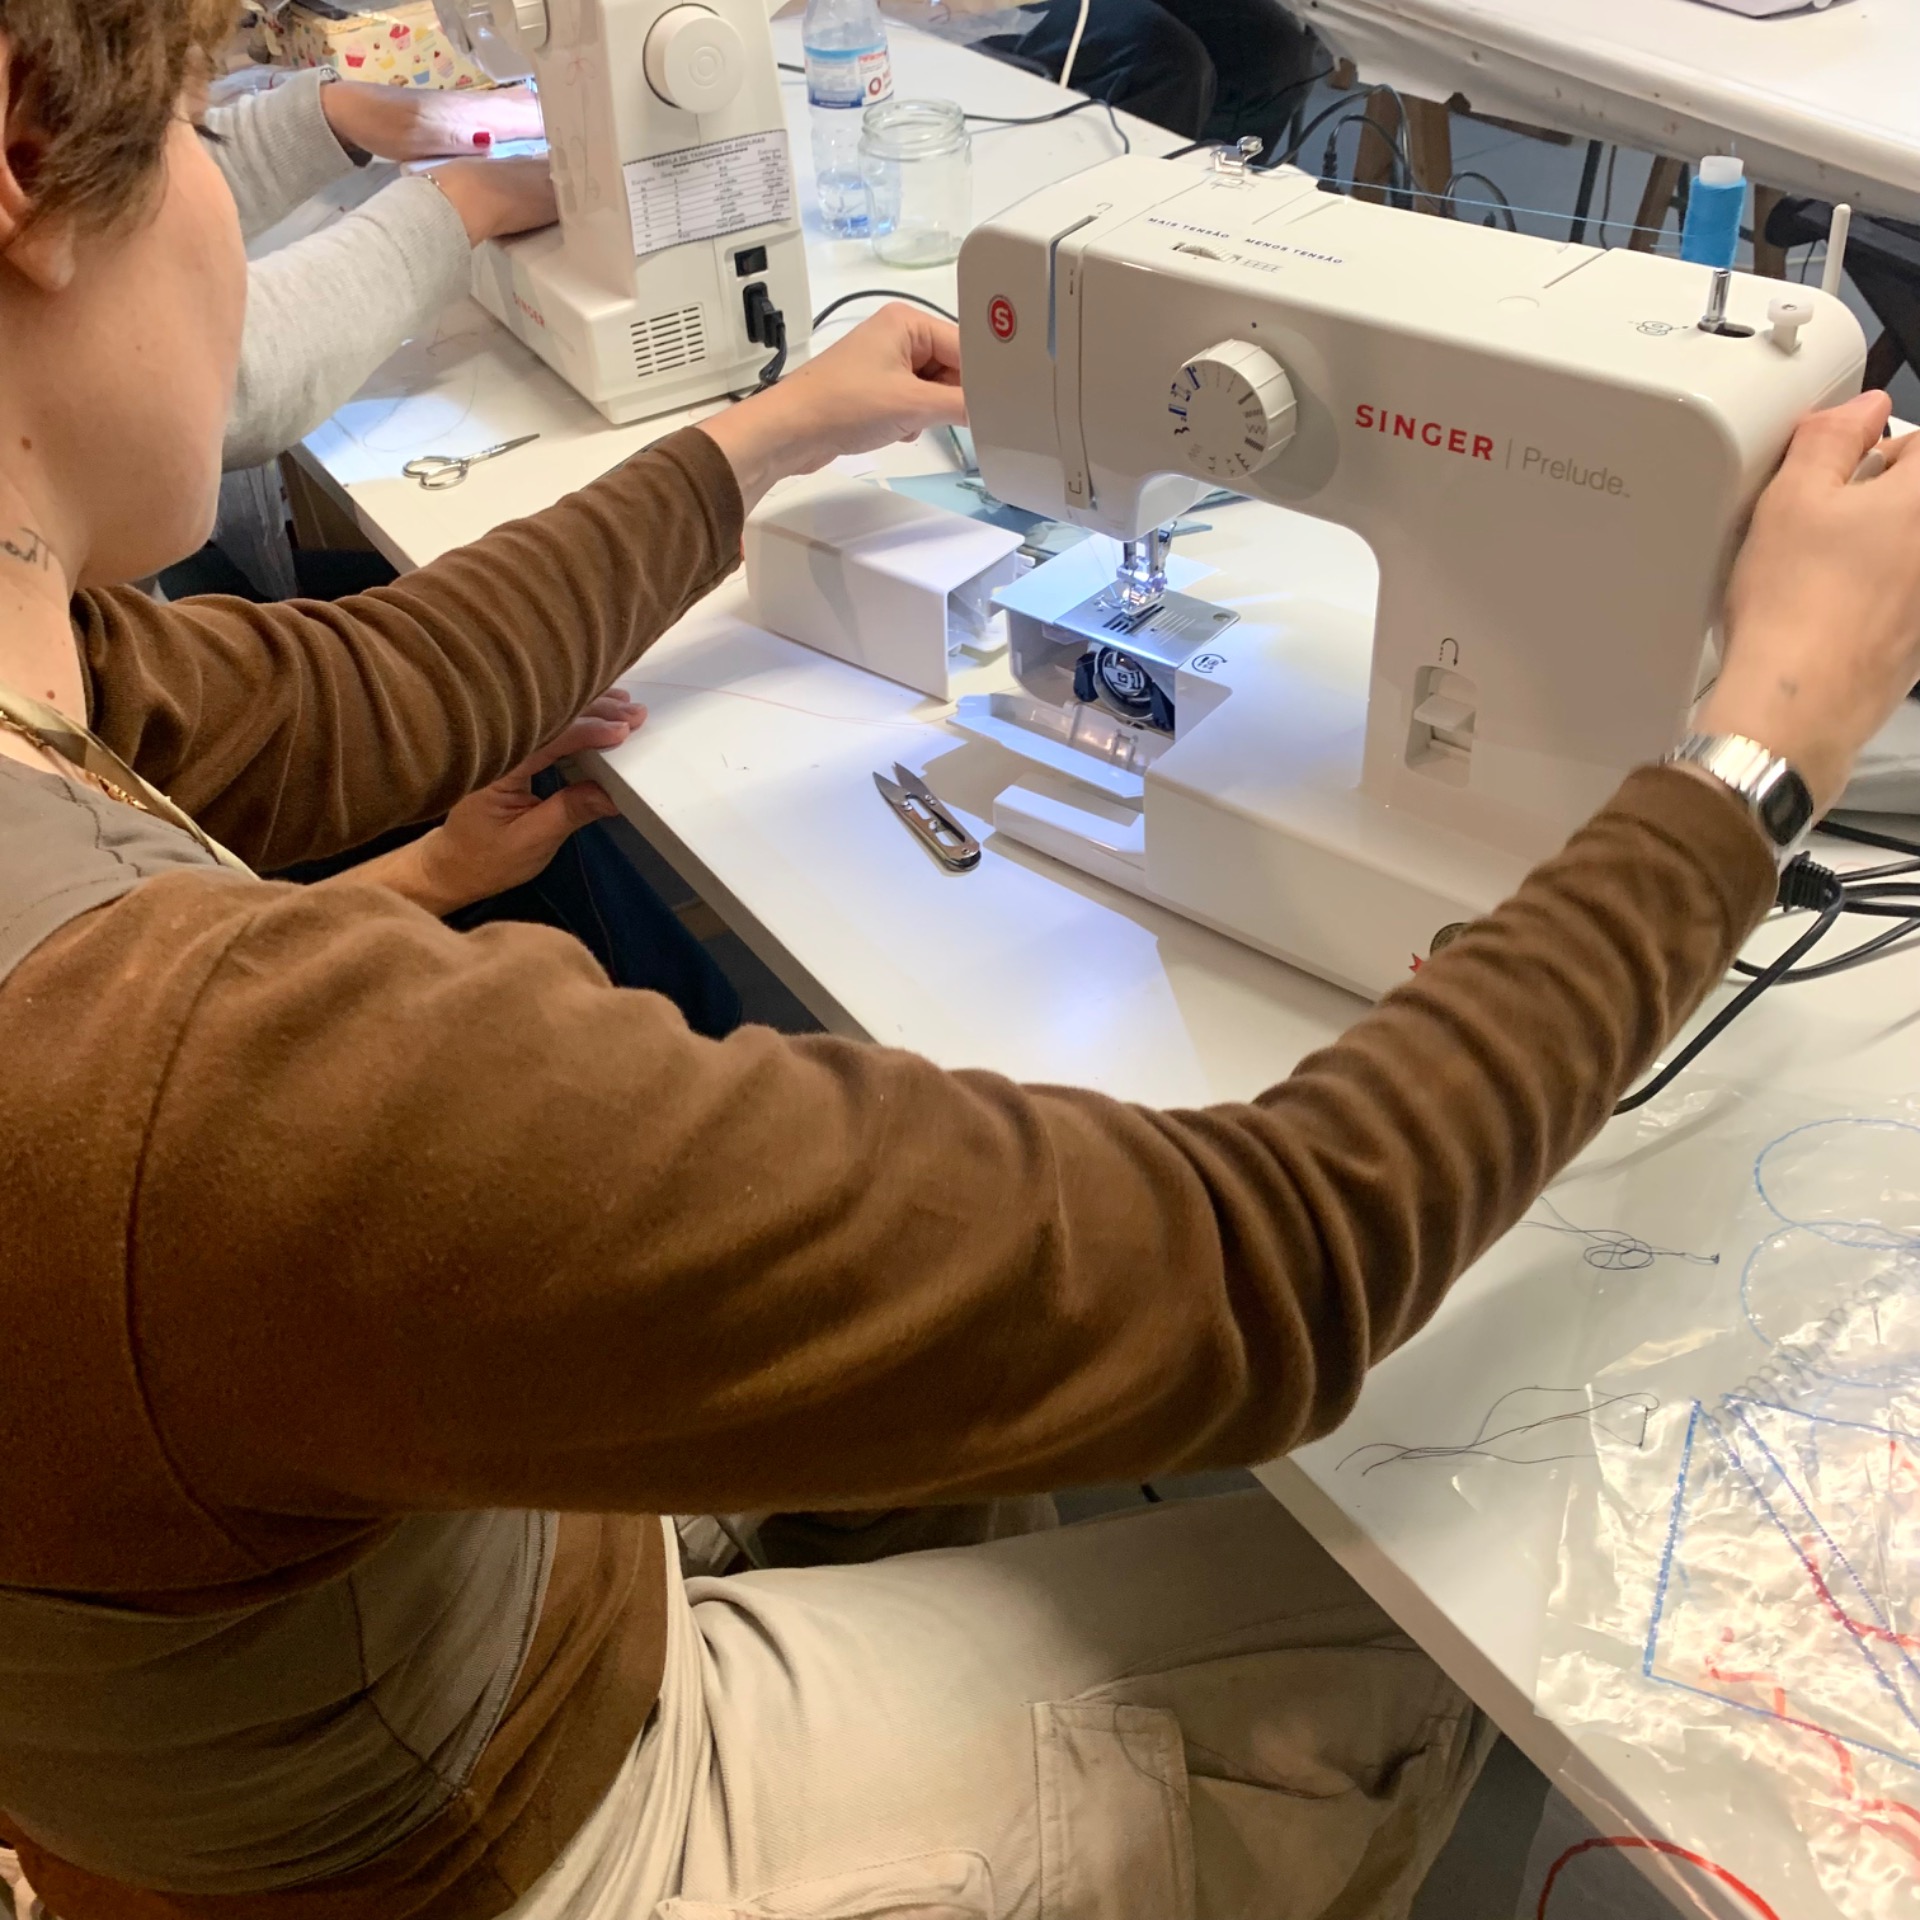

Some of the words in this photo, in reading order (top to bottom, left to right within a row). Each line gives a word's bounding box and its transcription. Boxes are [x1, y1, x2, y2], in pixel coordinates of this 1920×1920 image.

[652, 157, 678, 168] TABELA
[1147, 216, 1178, 228] MAIS
[1182, 224, 1231, 239] TENSÃO
[1244, 237, 1290, 252] MENOS
[1293, 248, 1344, 265] TENSÃO
[1355, 403, 1494, 461] SINGER
[1522, 446, 1624, 496] Prelude
